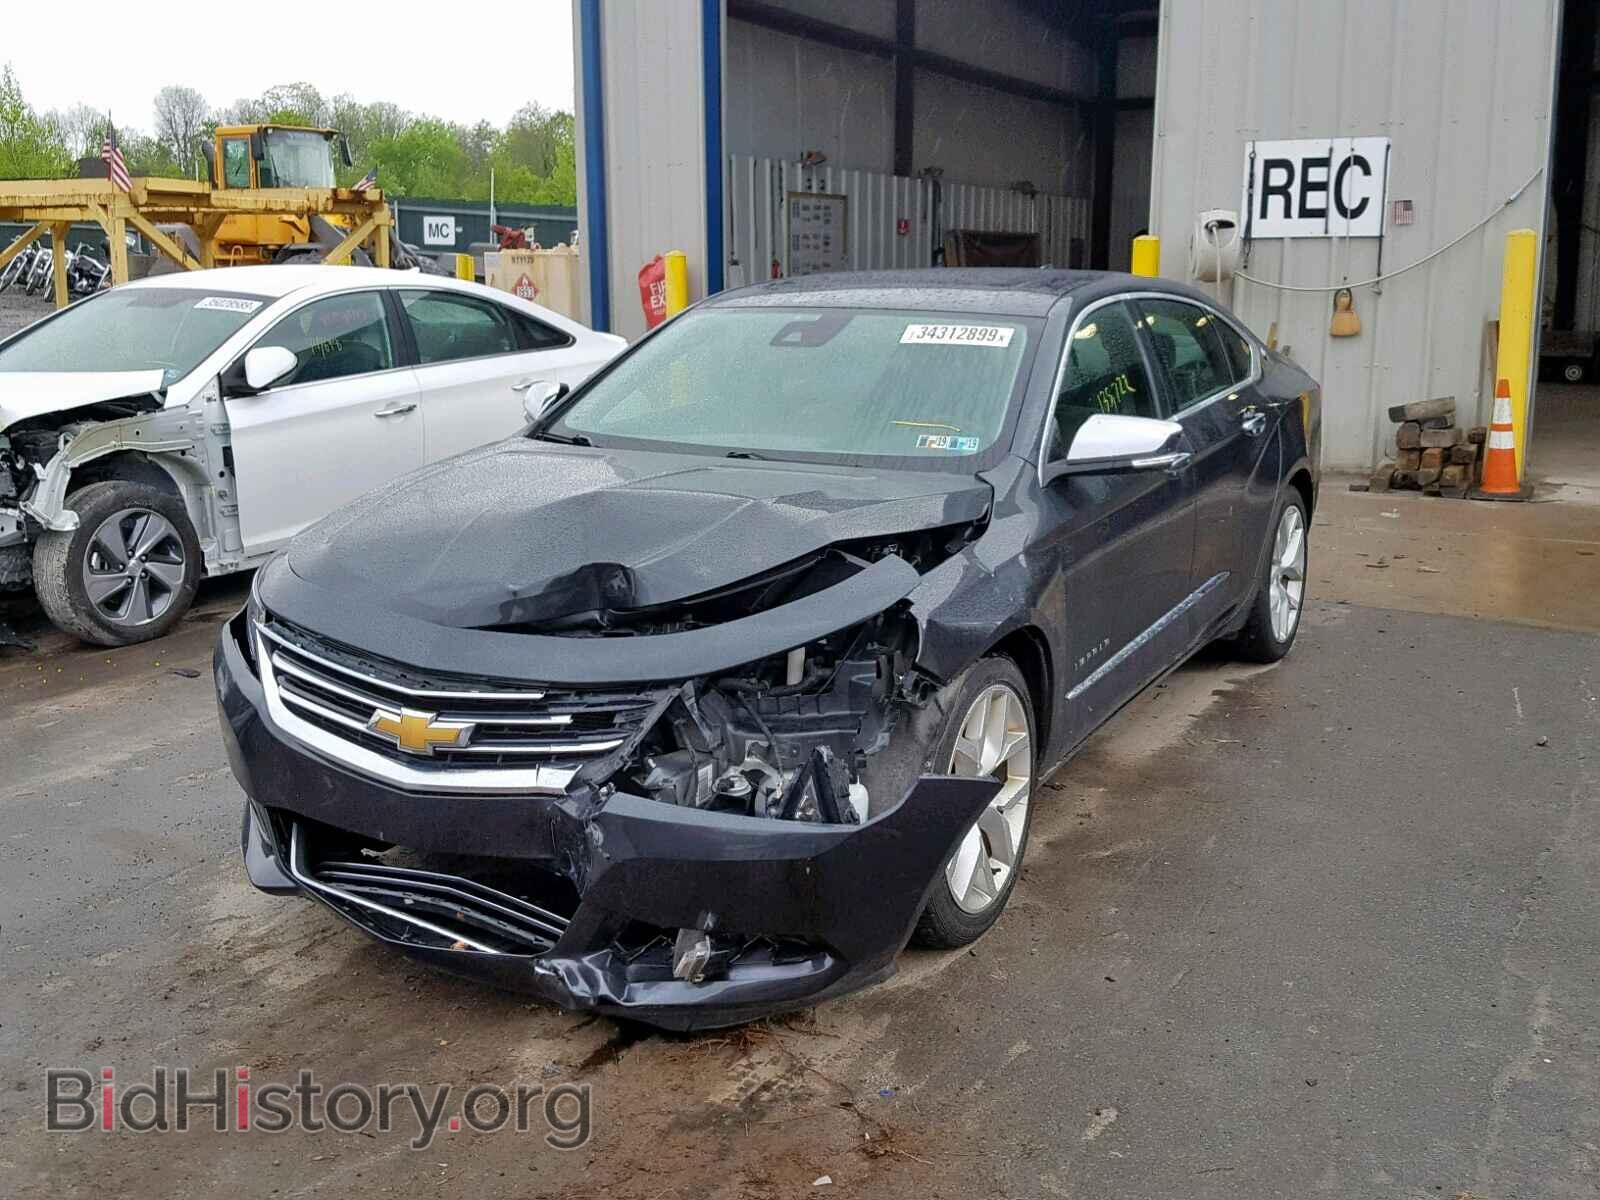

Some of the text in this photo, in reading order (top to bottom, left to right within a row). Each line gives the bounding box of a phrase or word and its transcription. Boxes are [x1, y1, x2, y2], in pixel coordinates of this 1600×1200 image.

[1260, 155, 1371, 220] REC
[428, 223, 449, 238] MC
[916, 326, 999, 342] 34312899
